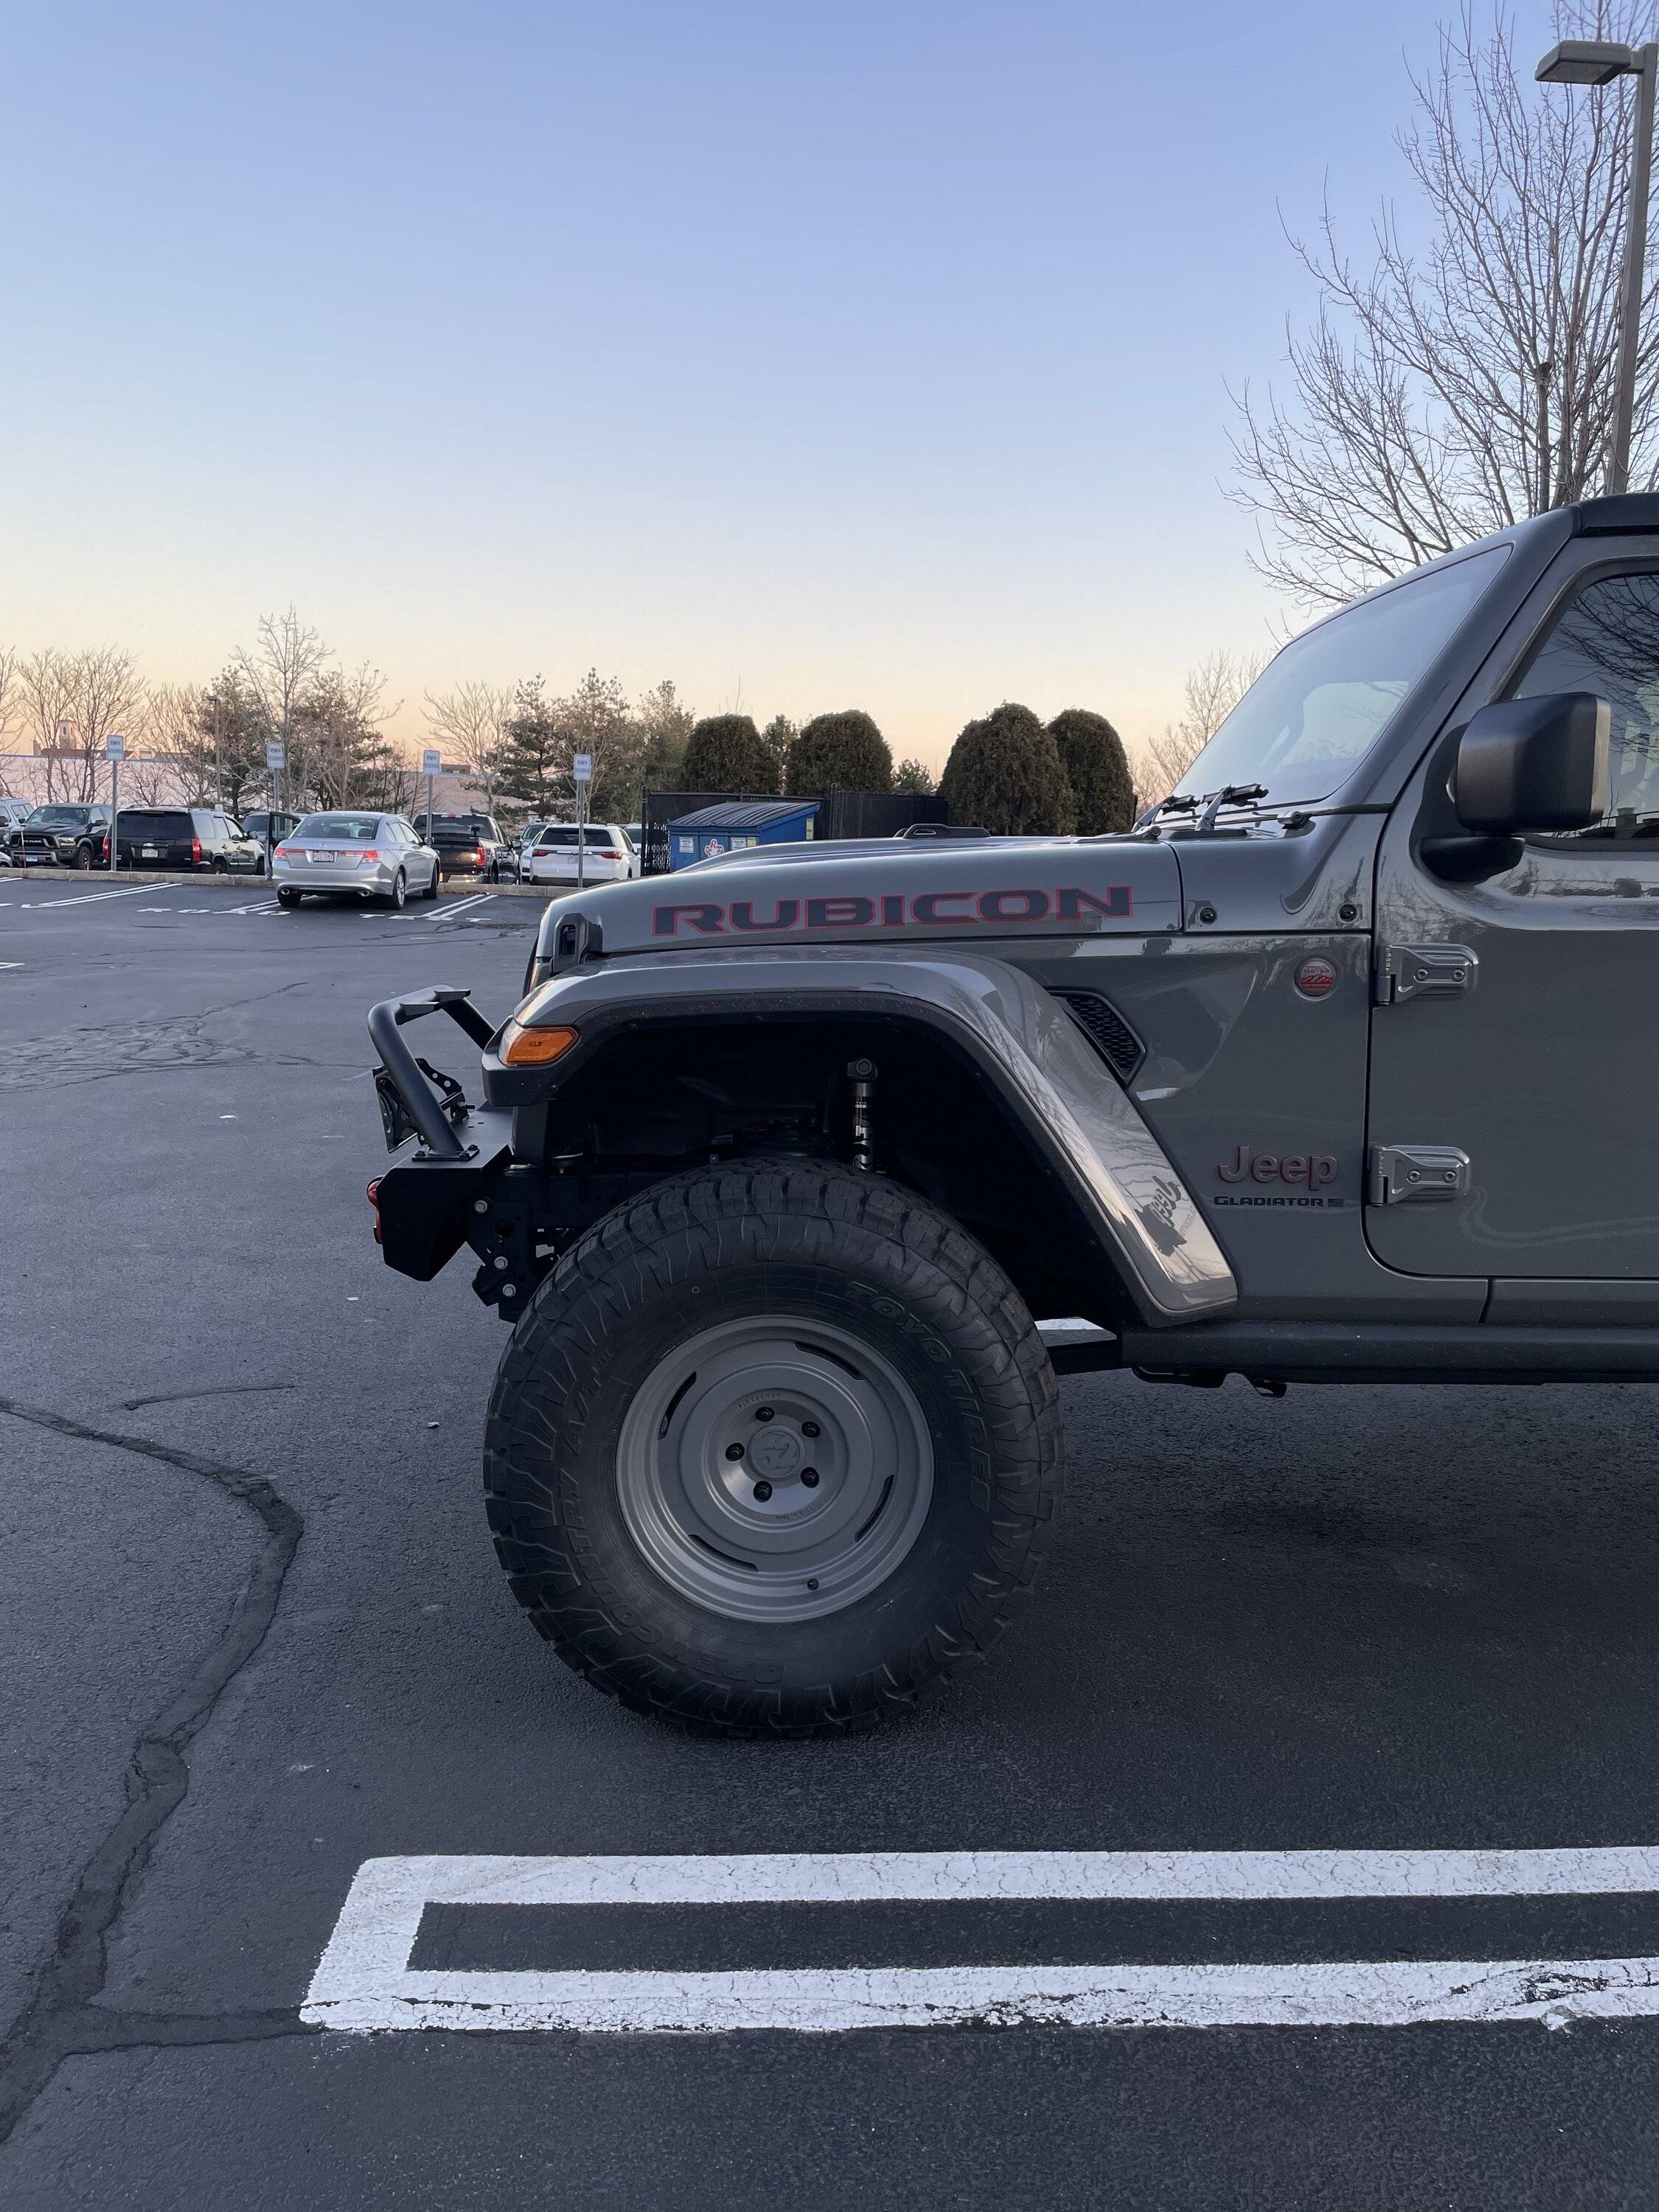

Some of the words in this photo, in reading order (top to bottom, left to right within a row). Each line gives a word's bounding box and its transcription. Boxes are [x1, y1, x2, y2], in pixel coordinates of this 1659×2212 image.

[652, 885, 1133, 936] RUBICON
[1217, 1144, 1339, 1191] Jeep
[1214, 1196, 1324, 1207] GLADIATOR
[844, 1280, 953, 1363] TOYO
[943, 1368, 992, 1514] TIRES
